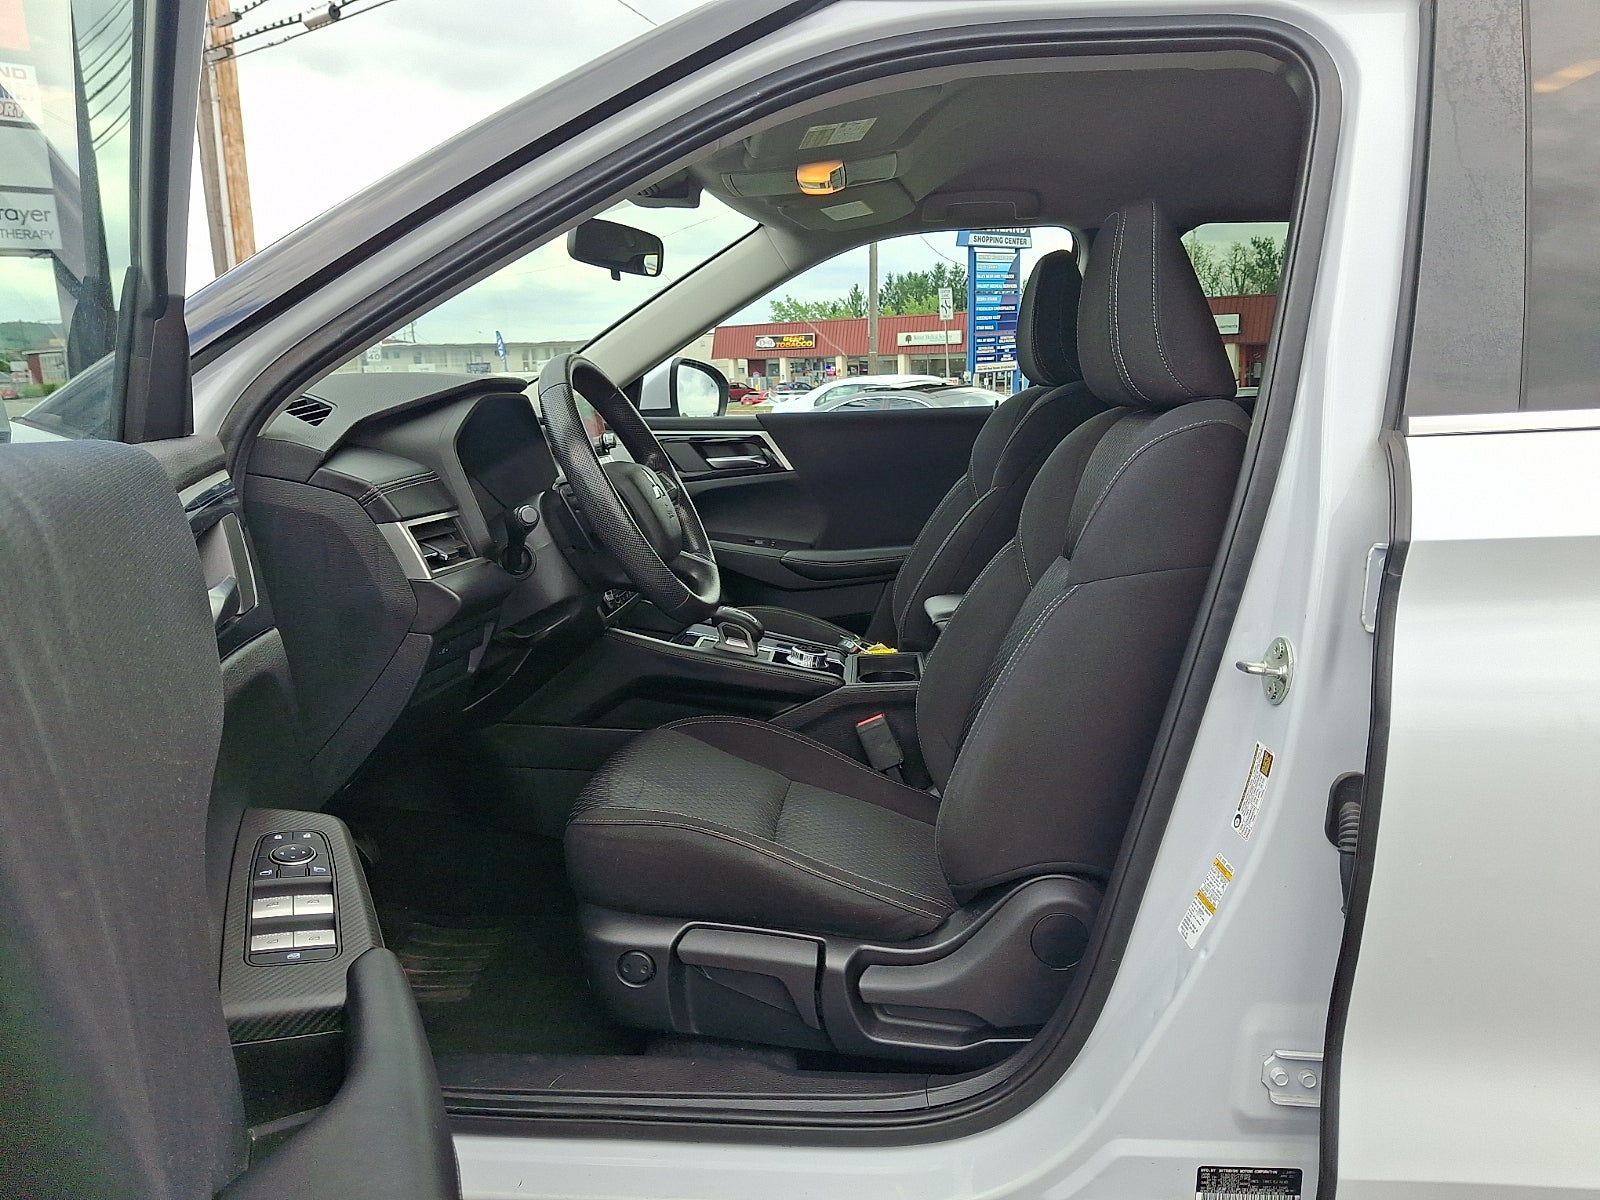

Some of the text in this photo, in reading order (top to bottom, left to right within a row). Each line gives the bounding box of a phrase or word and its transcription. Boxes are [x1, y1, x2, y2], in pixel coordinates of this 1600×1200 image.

[973, 235, 1027, 246] SHOPPING CENTER
[776, 340, 813, 348] TOBACCO
